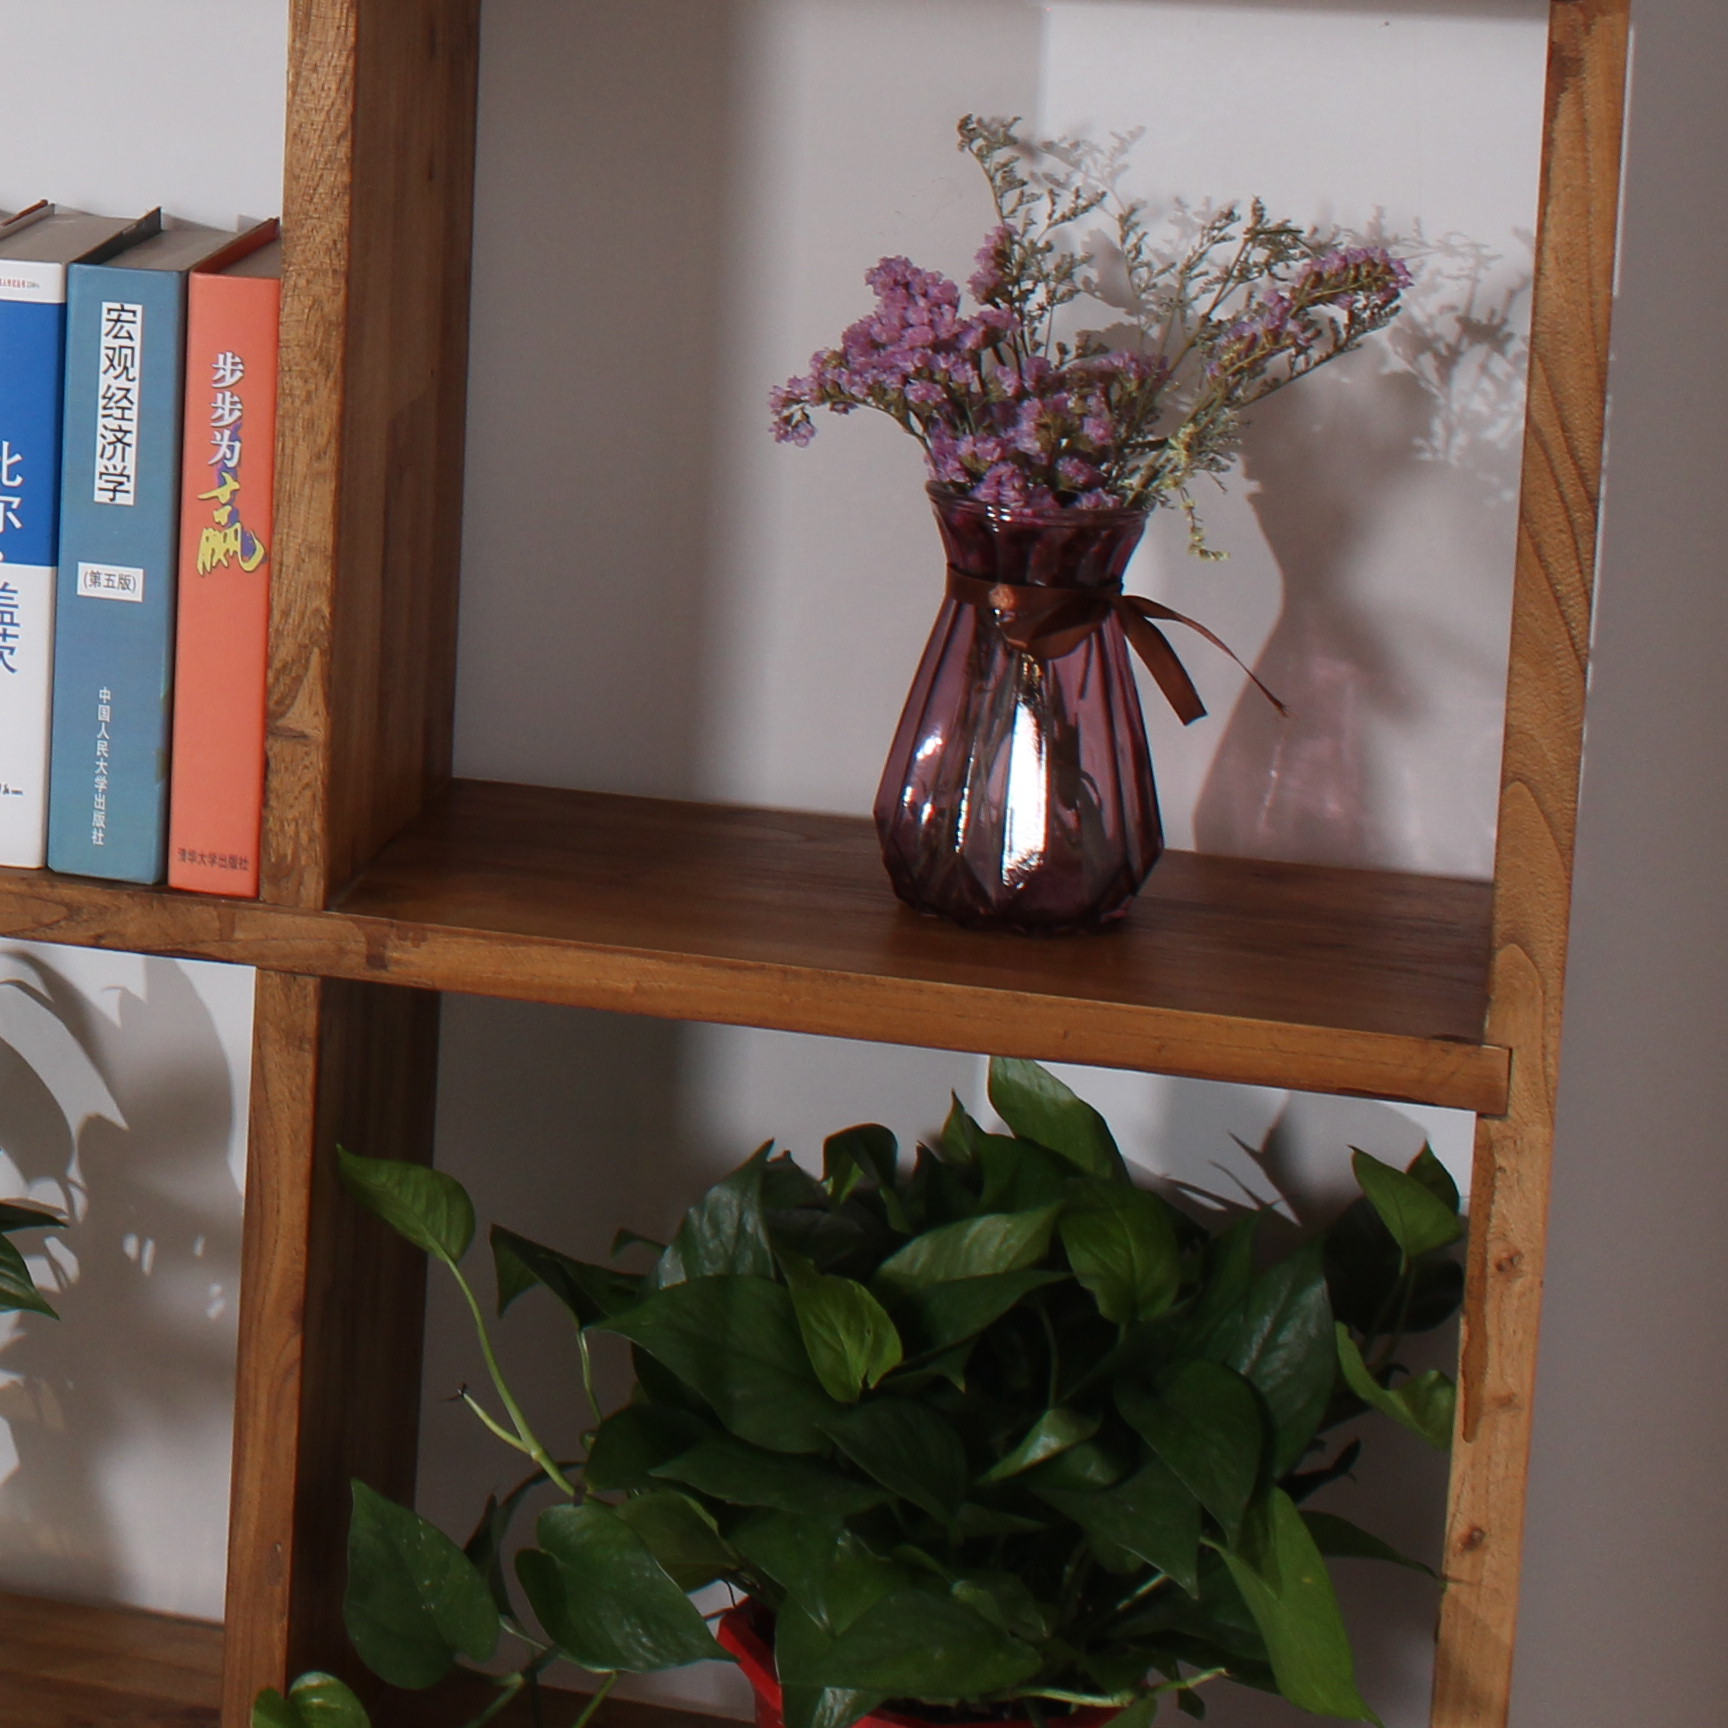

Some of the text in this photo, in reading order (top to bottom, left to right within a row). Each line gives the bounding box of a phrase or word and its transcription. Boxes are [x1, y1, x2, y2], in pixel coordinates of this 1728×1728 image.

[98, 304, 139, 503] 宏观经济学
[197, 351, 267, 577] 步步为赢
[83, 569, 137, 594] (第五版)
[91, 686, 112, 846] 中国人民大学出版社
[177, 848, 249, 871] 清华大学出版社
